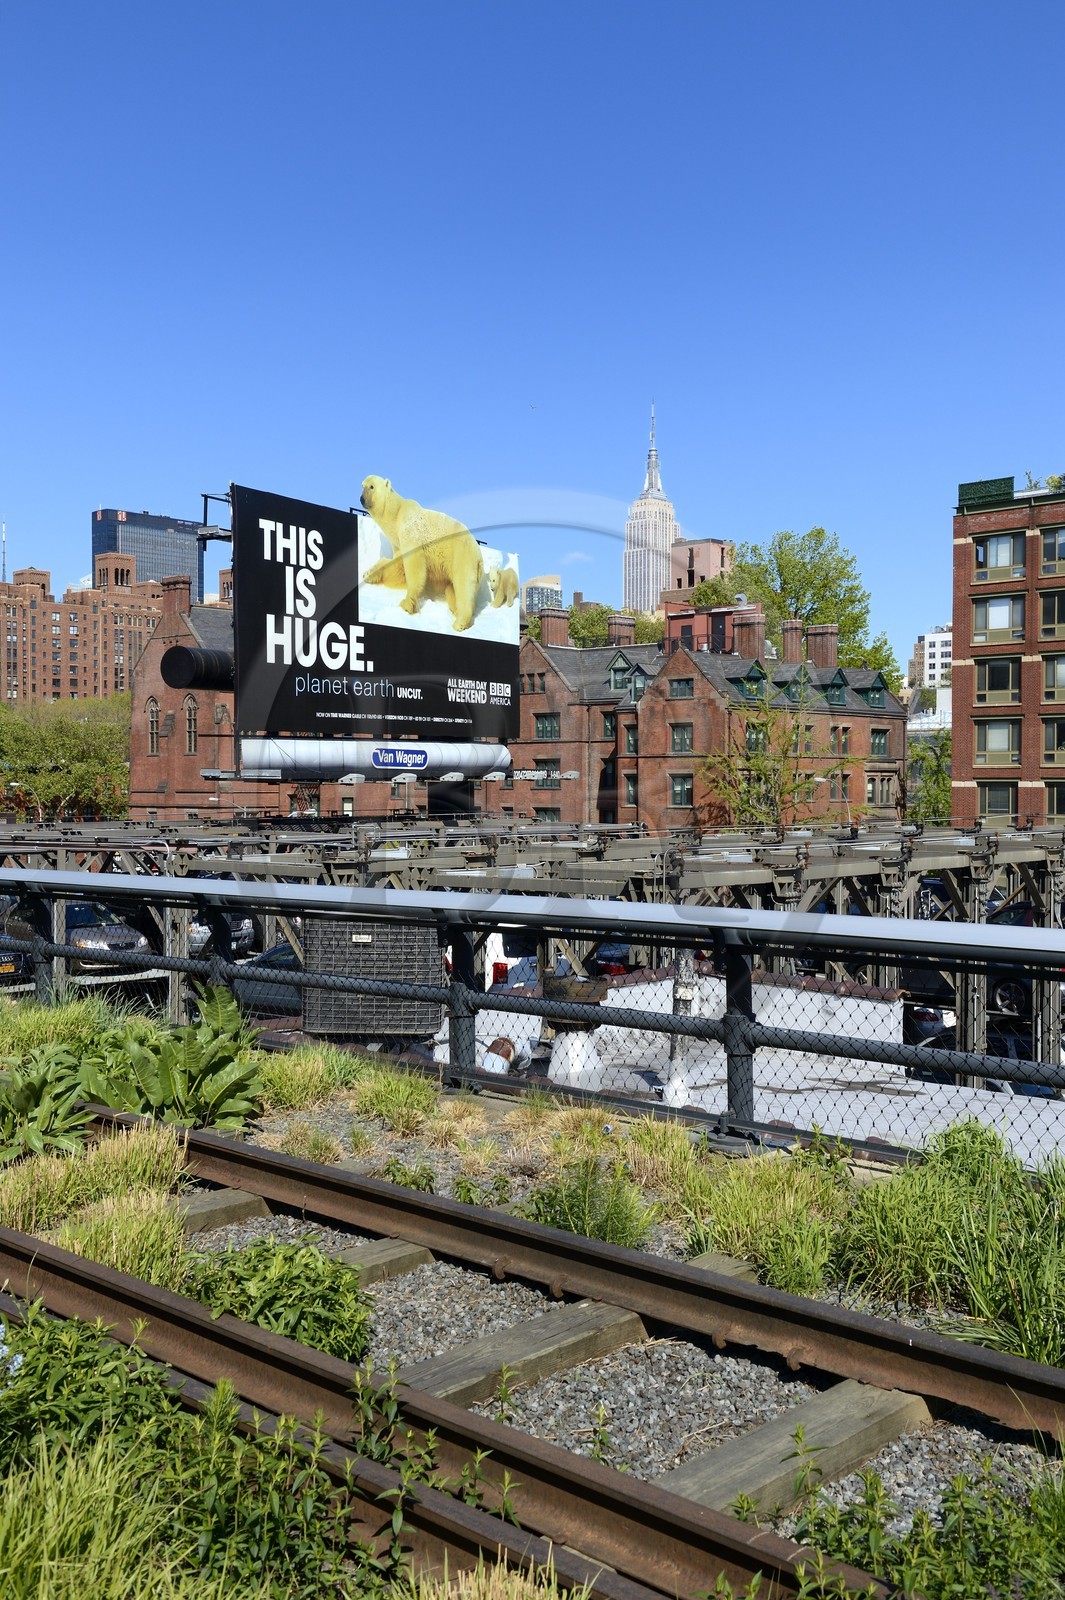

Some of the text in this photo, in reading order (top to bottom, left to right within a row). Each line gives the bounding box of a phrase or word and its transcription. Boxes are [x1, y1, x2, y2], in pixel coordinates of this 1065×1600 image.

[258, 518, 324, 571] THIS
[285, 565, 317, 619] IS
[266, 613, 374, 672] HUGE.
[295, 673, 423, 699] planet earth UNCUT.
[447, 678, 487, 691] ALL EARTH DAY
[490, 682, 511, 697] BBC
[447, 687, 487, 704] WEEKEND
[490, 697, 511, 706] AMERICA
[377, 749, 426, 767] Van Wagner
